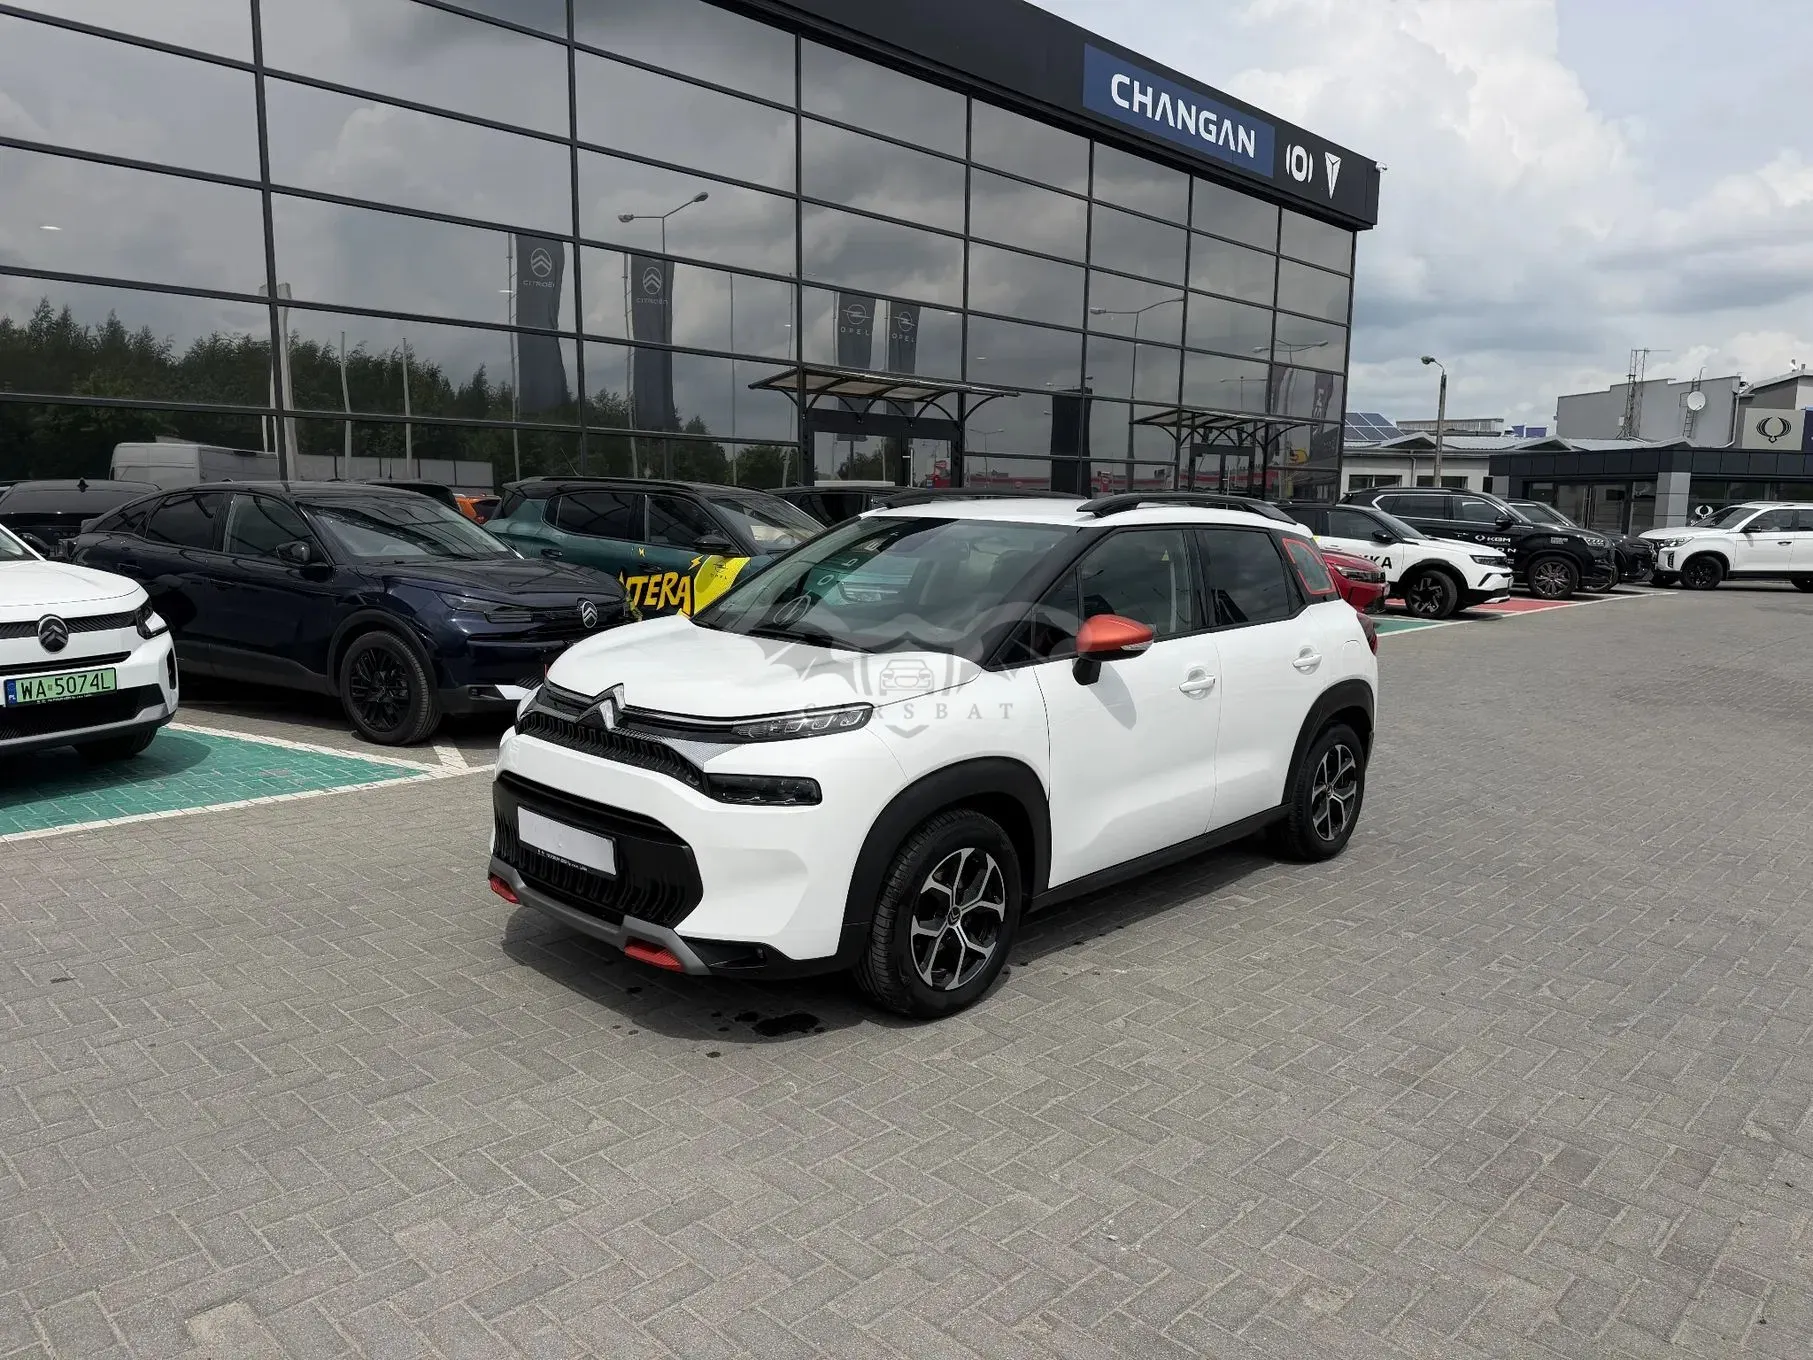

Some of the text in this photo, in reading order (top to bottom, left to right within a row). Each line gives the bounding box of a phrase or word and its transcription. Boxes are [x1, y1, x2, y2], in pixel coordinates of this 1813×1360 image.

[1110, 73, 1256, 159] CHANGAN
[840, 326, 870, 336] OPEL
[20, 679, 47, 700] WA
[54, 672, 111, 696] 5074L
